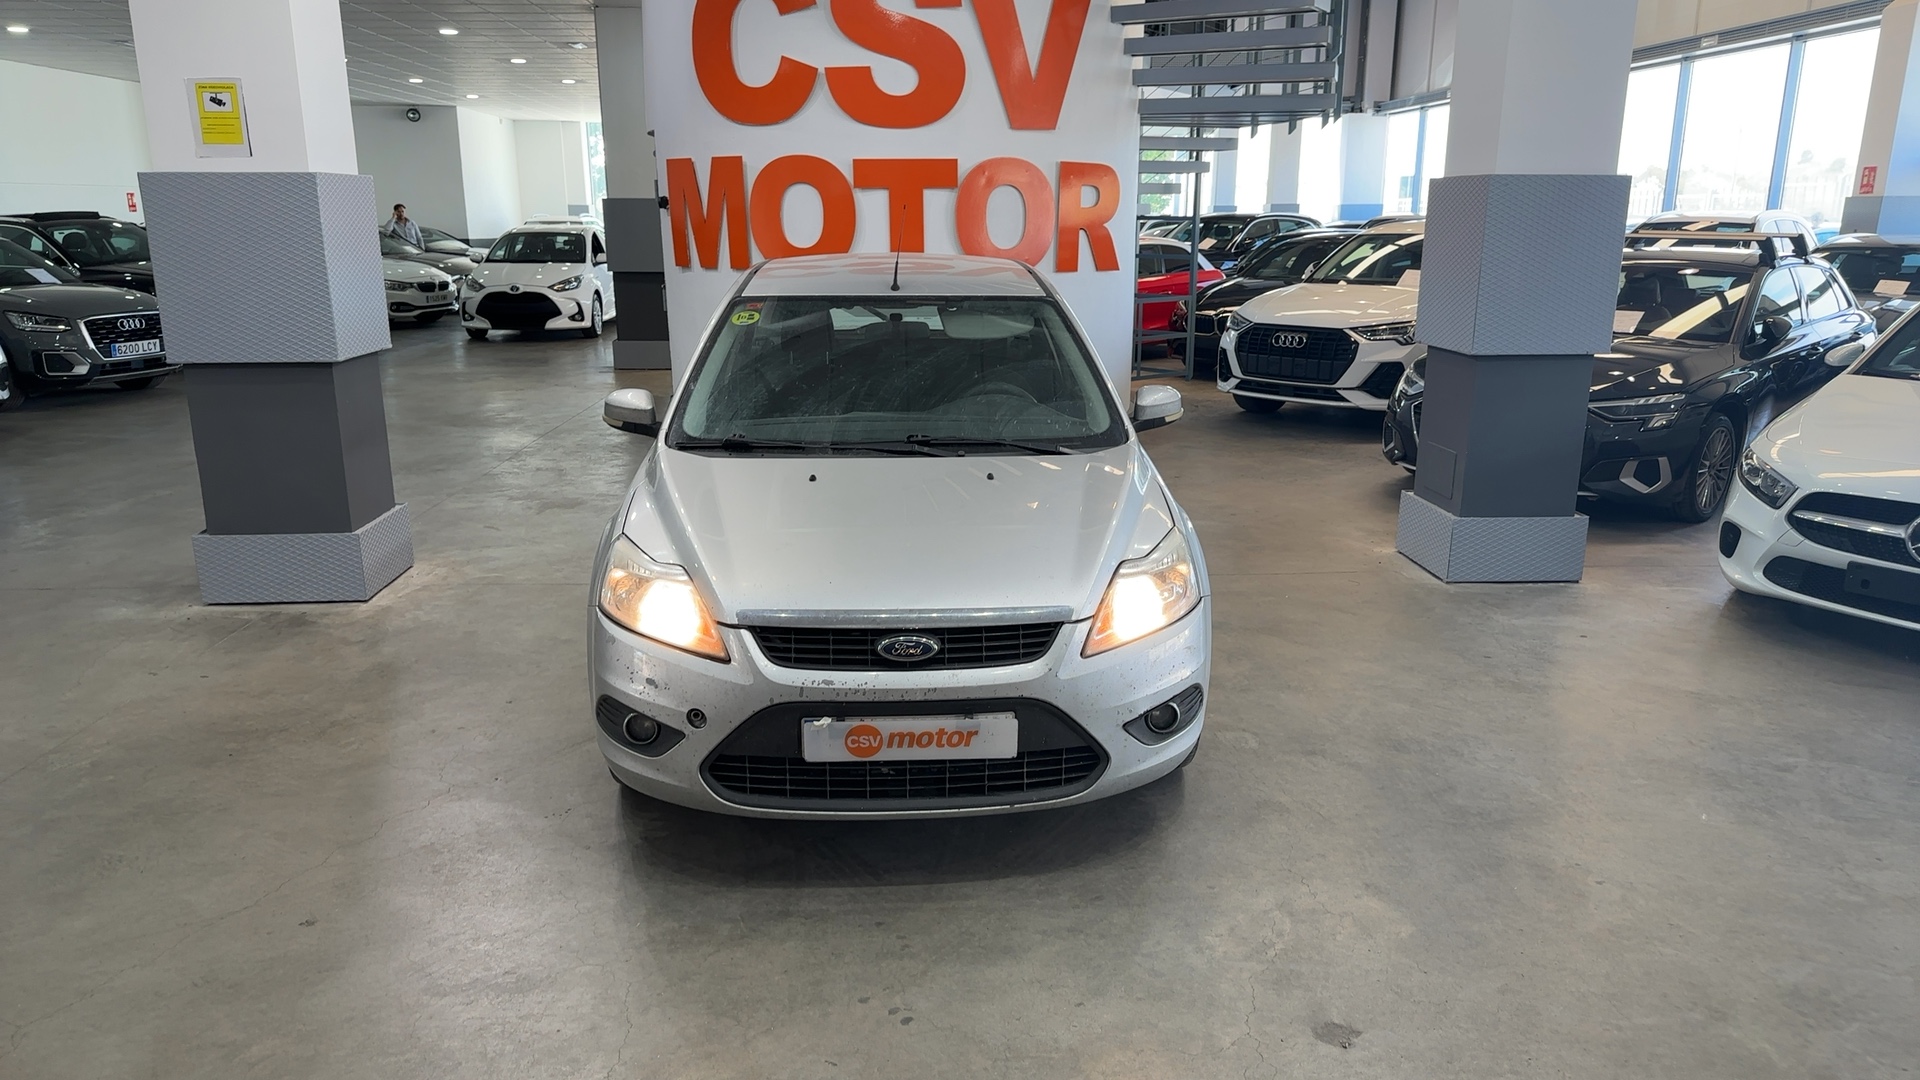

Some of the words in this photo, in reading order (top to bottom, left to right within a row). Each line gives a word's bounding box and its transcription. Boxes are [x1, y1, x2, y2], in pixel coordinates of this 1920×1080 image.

[692, 0, 1089, 130] CSV
[666, 154, 1121, 272] MOTOR
[117, 343, 140, 355] 6200
[141, 341, 157, 352] LCY
[892, 642, 923, 655] Ford
[886, 728, 979, 749] motor
